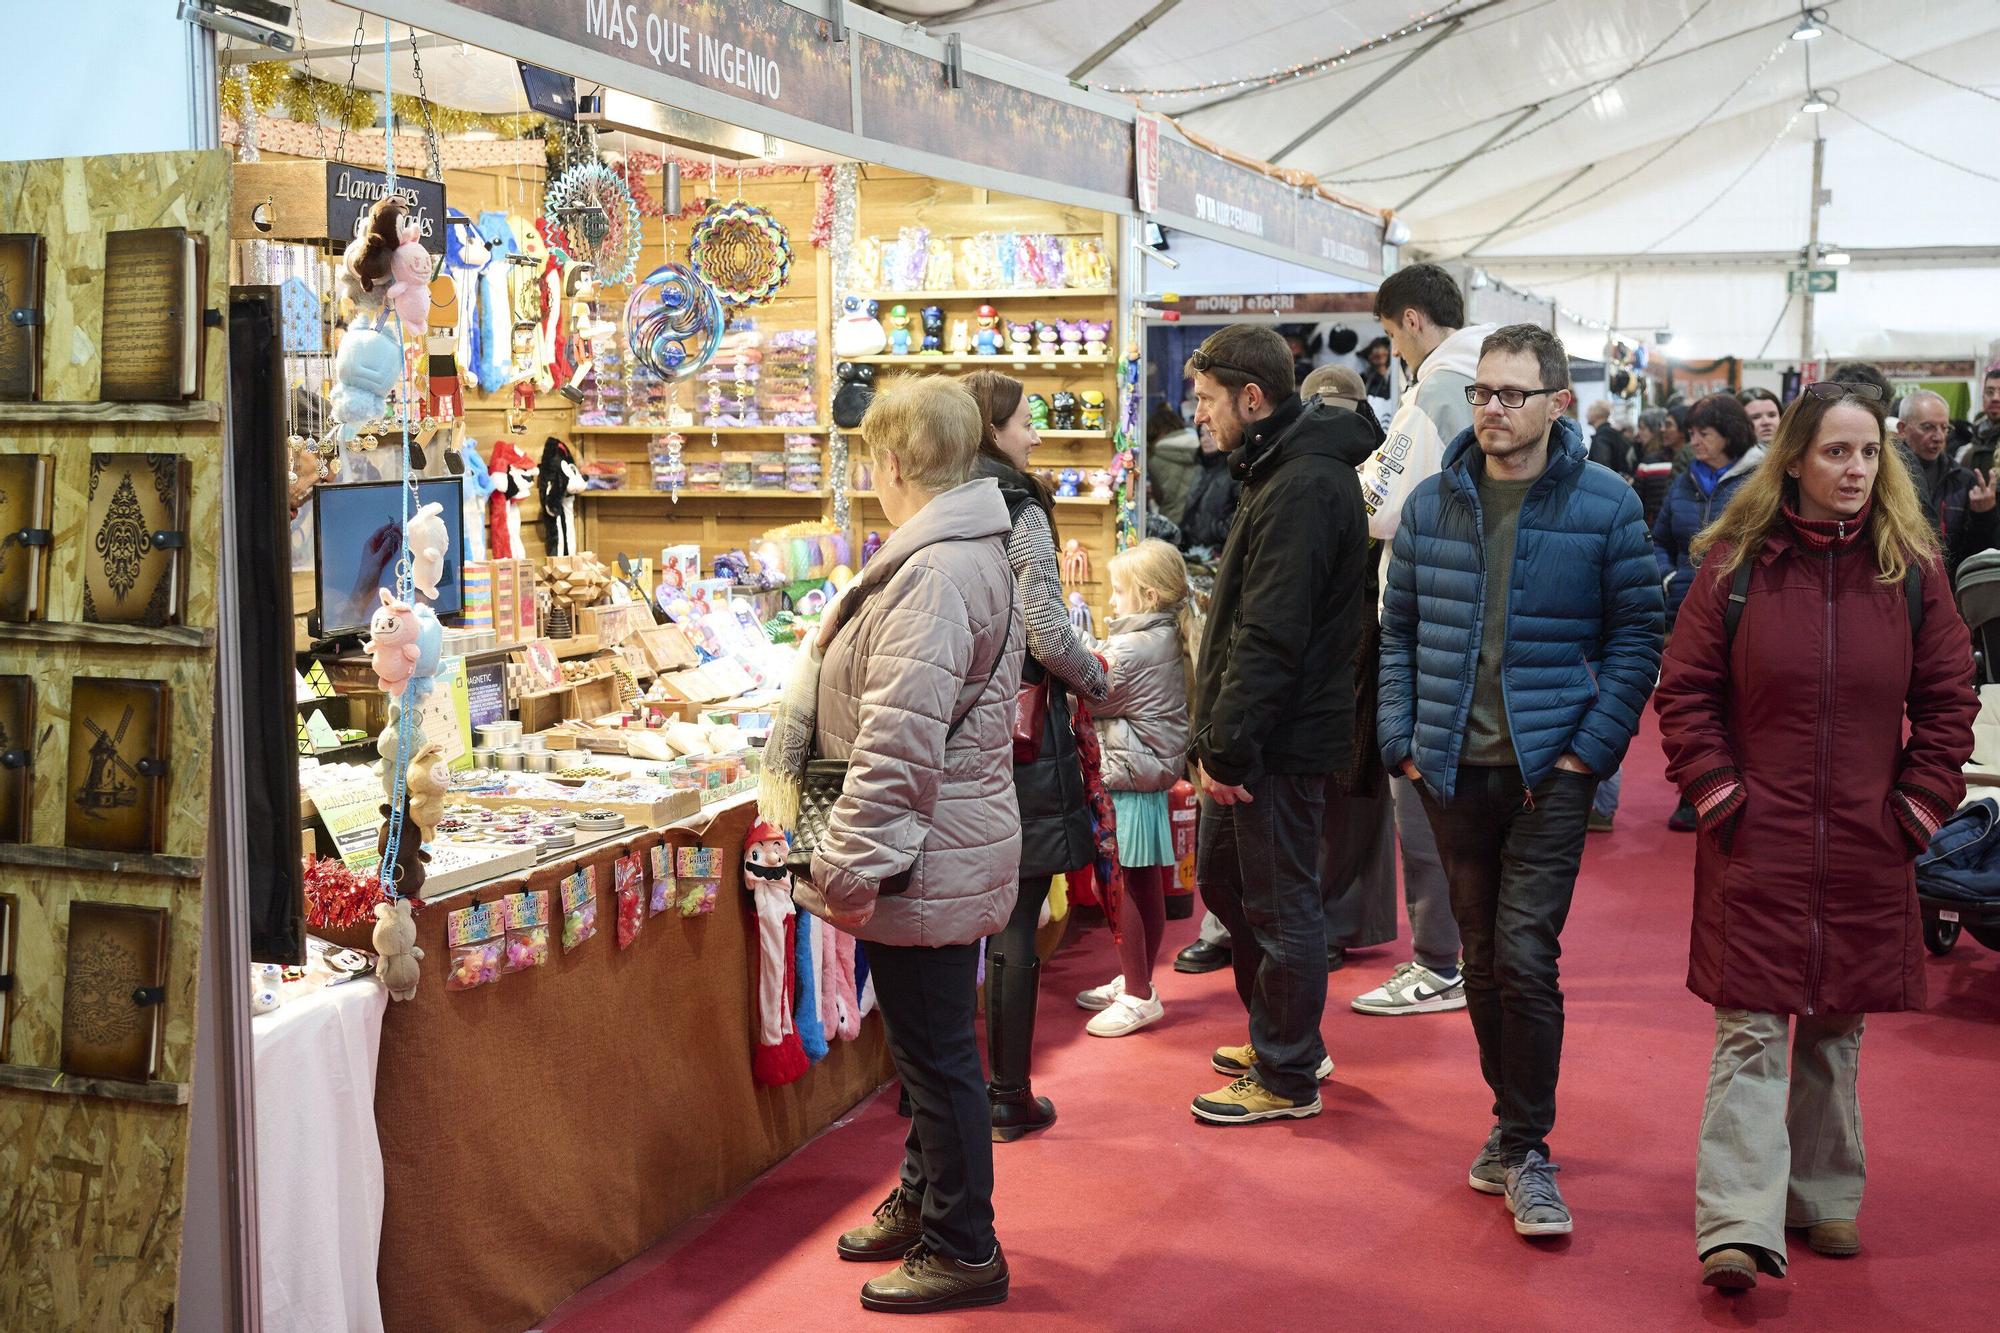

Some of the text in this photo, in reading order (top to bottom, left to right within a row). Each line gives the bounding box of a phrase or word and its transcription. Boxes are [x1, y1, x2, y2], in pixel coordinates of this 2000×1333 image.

[646, 13, 691, 68] QUE
[699, 32, 780, 100] INGENIO
[1383, 430, 1412, 461] 18
